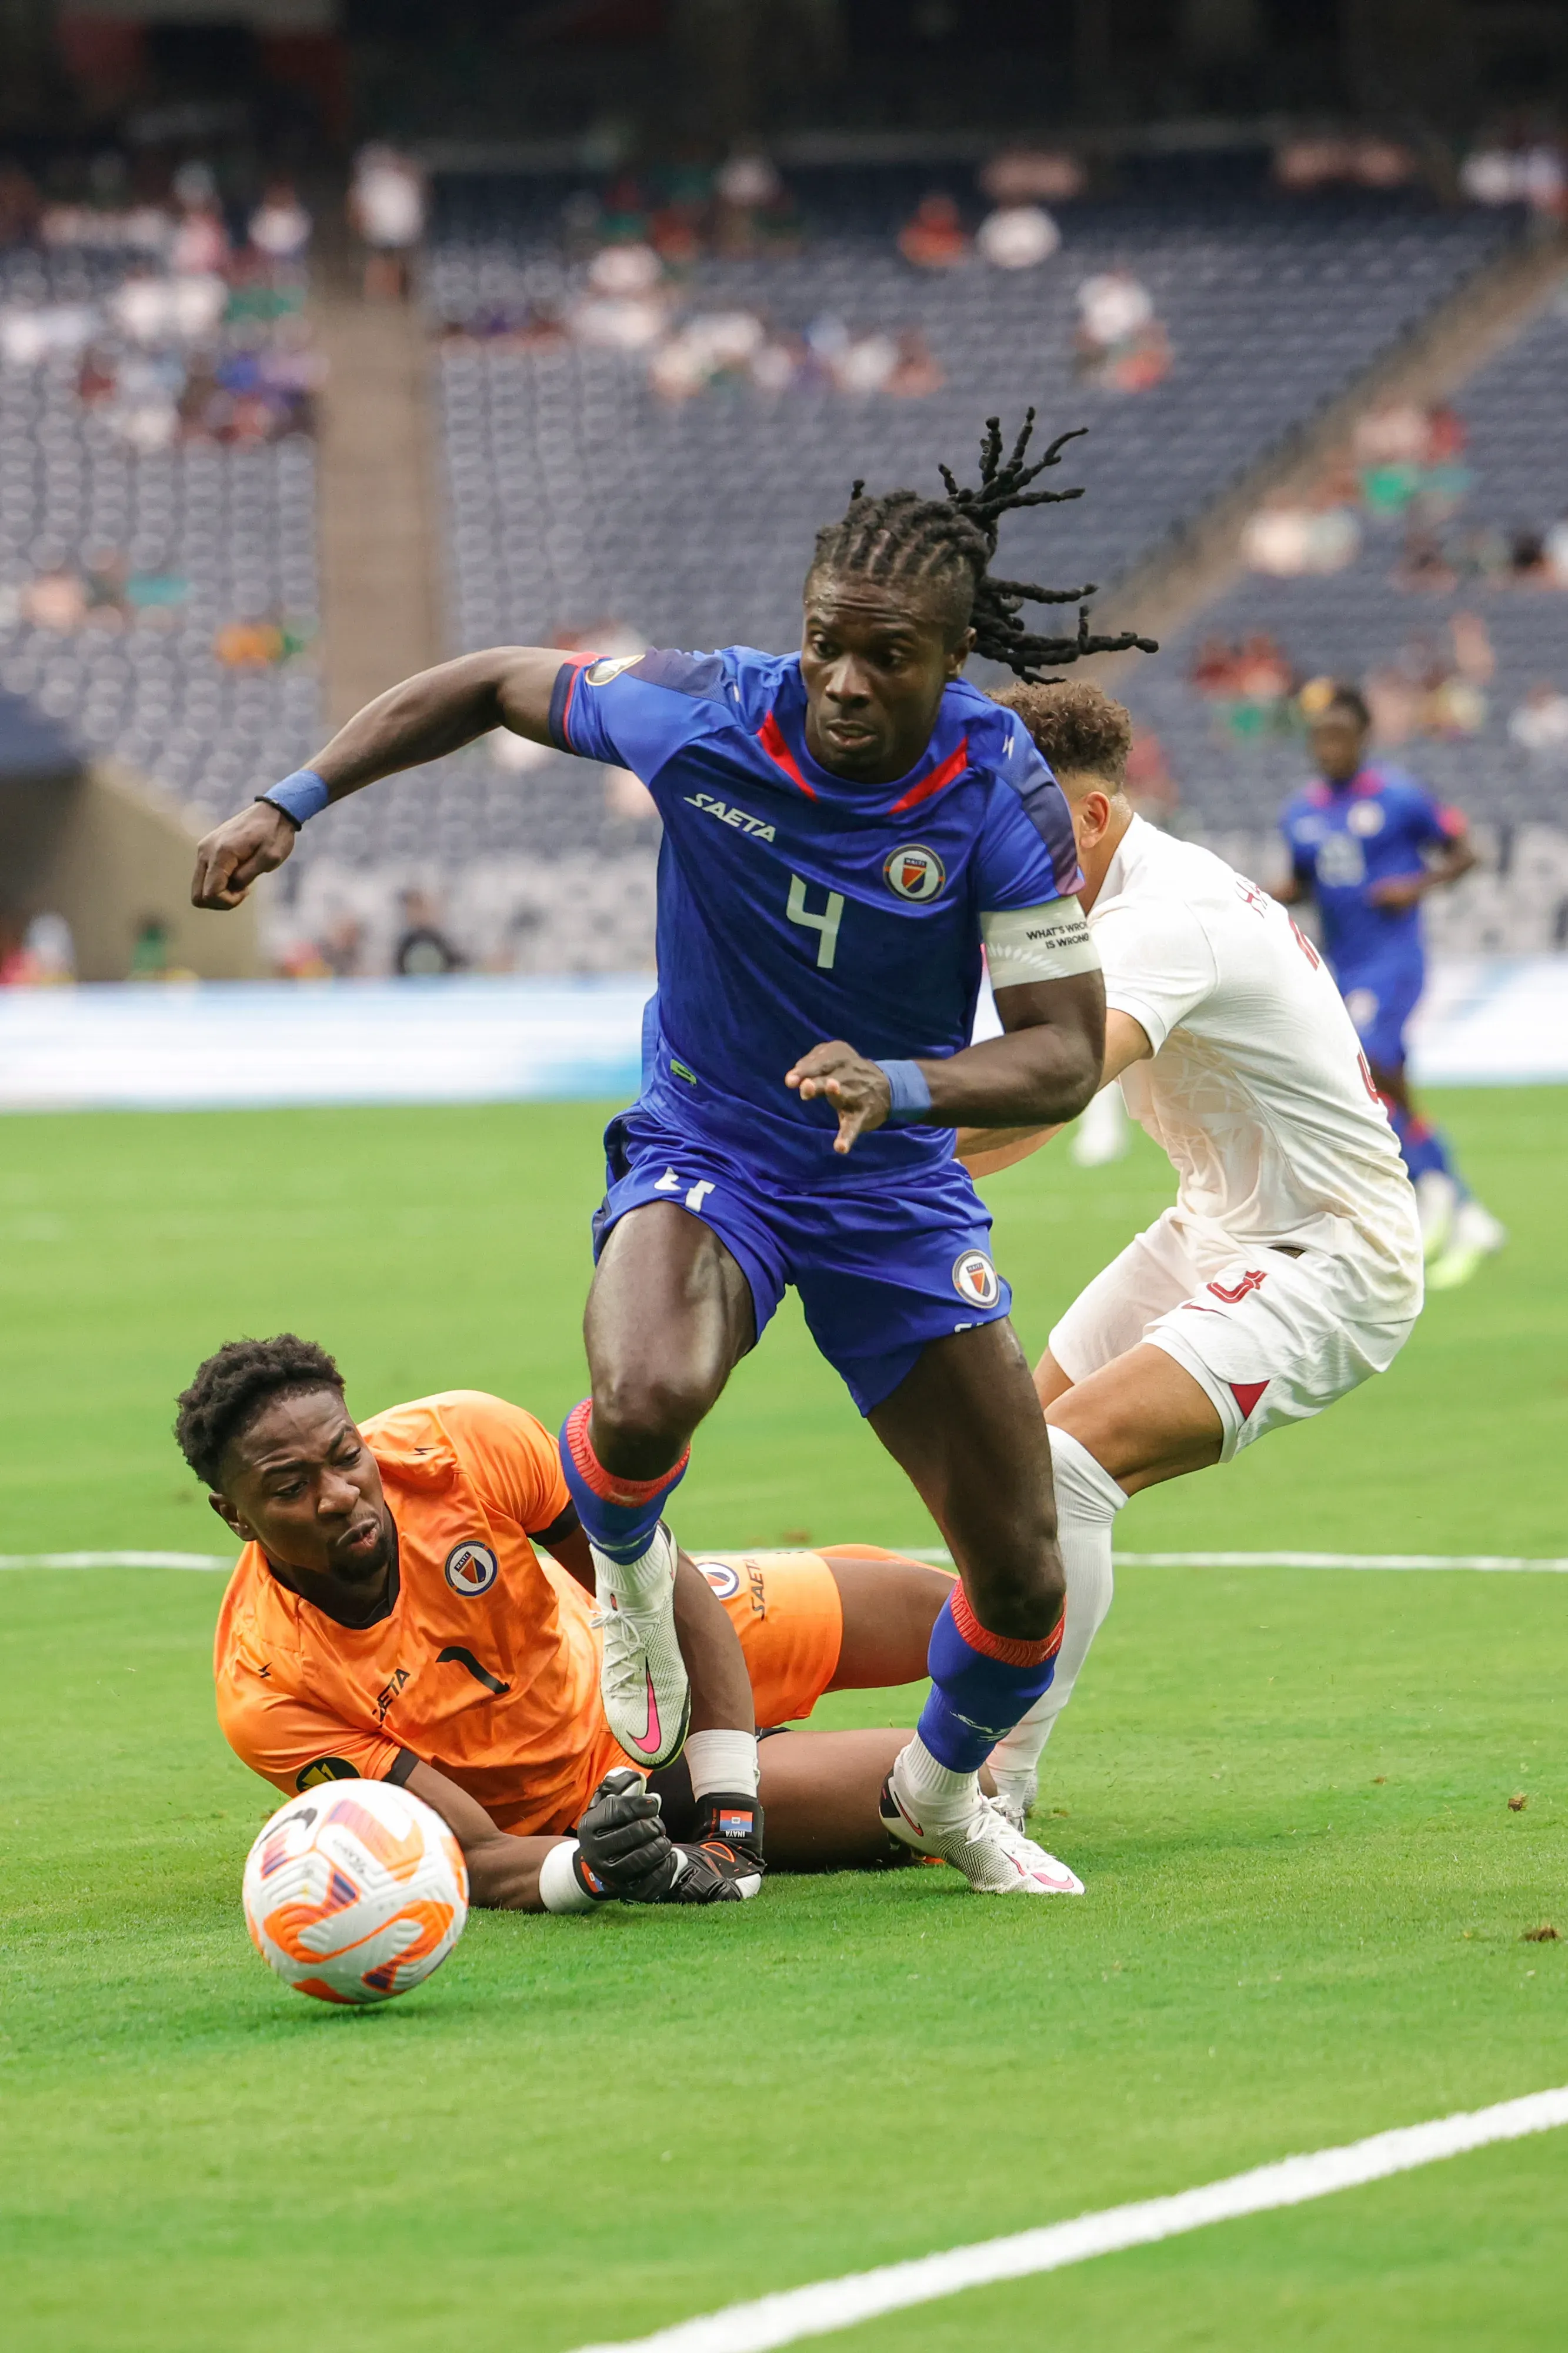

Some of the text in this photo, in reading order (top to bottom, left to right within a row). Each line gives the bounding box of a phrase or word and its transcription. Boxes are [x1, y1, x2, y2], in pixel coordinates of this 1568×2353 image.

[683, 793, 776, 842] SAETA
[786, 874, 844, 969] 4
[1026, 921, 1087, 940] WHAT'S WRO
[1045, 933, 1089, 949] IS WRONG
[456, 1554, 469, 1569] HAITI
[742, 1559, 765, 1621] SAETA
